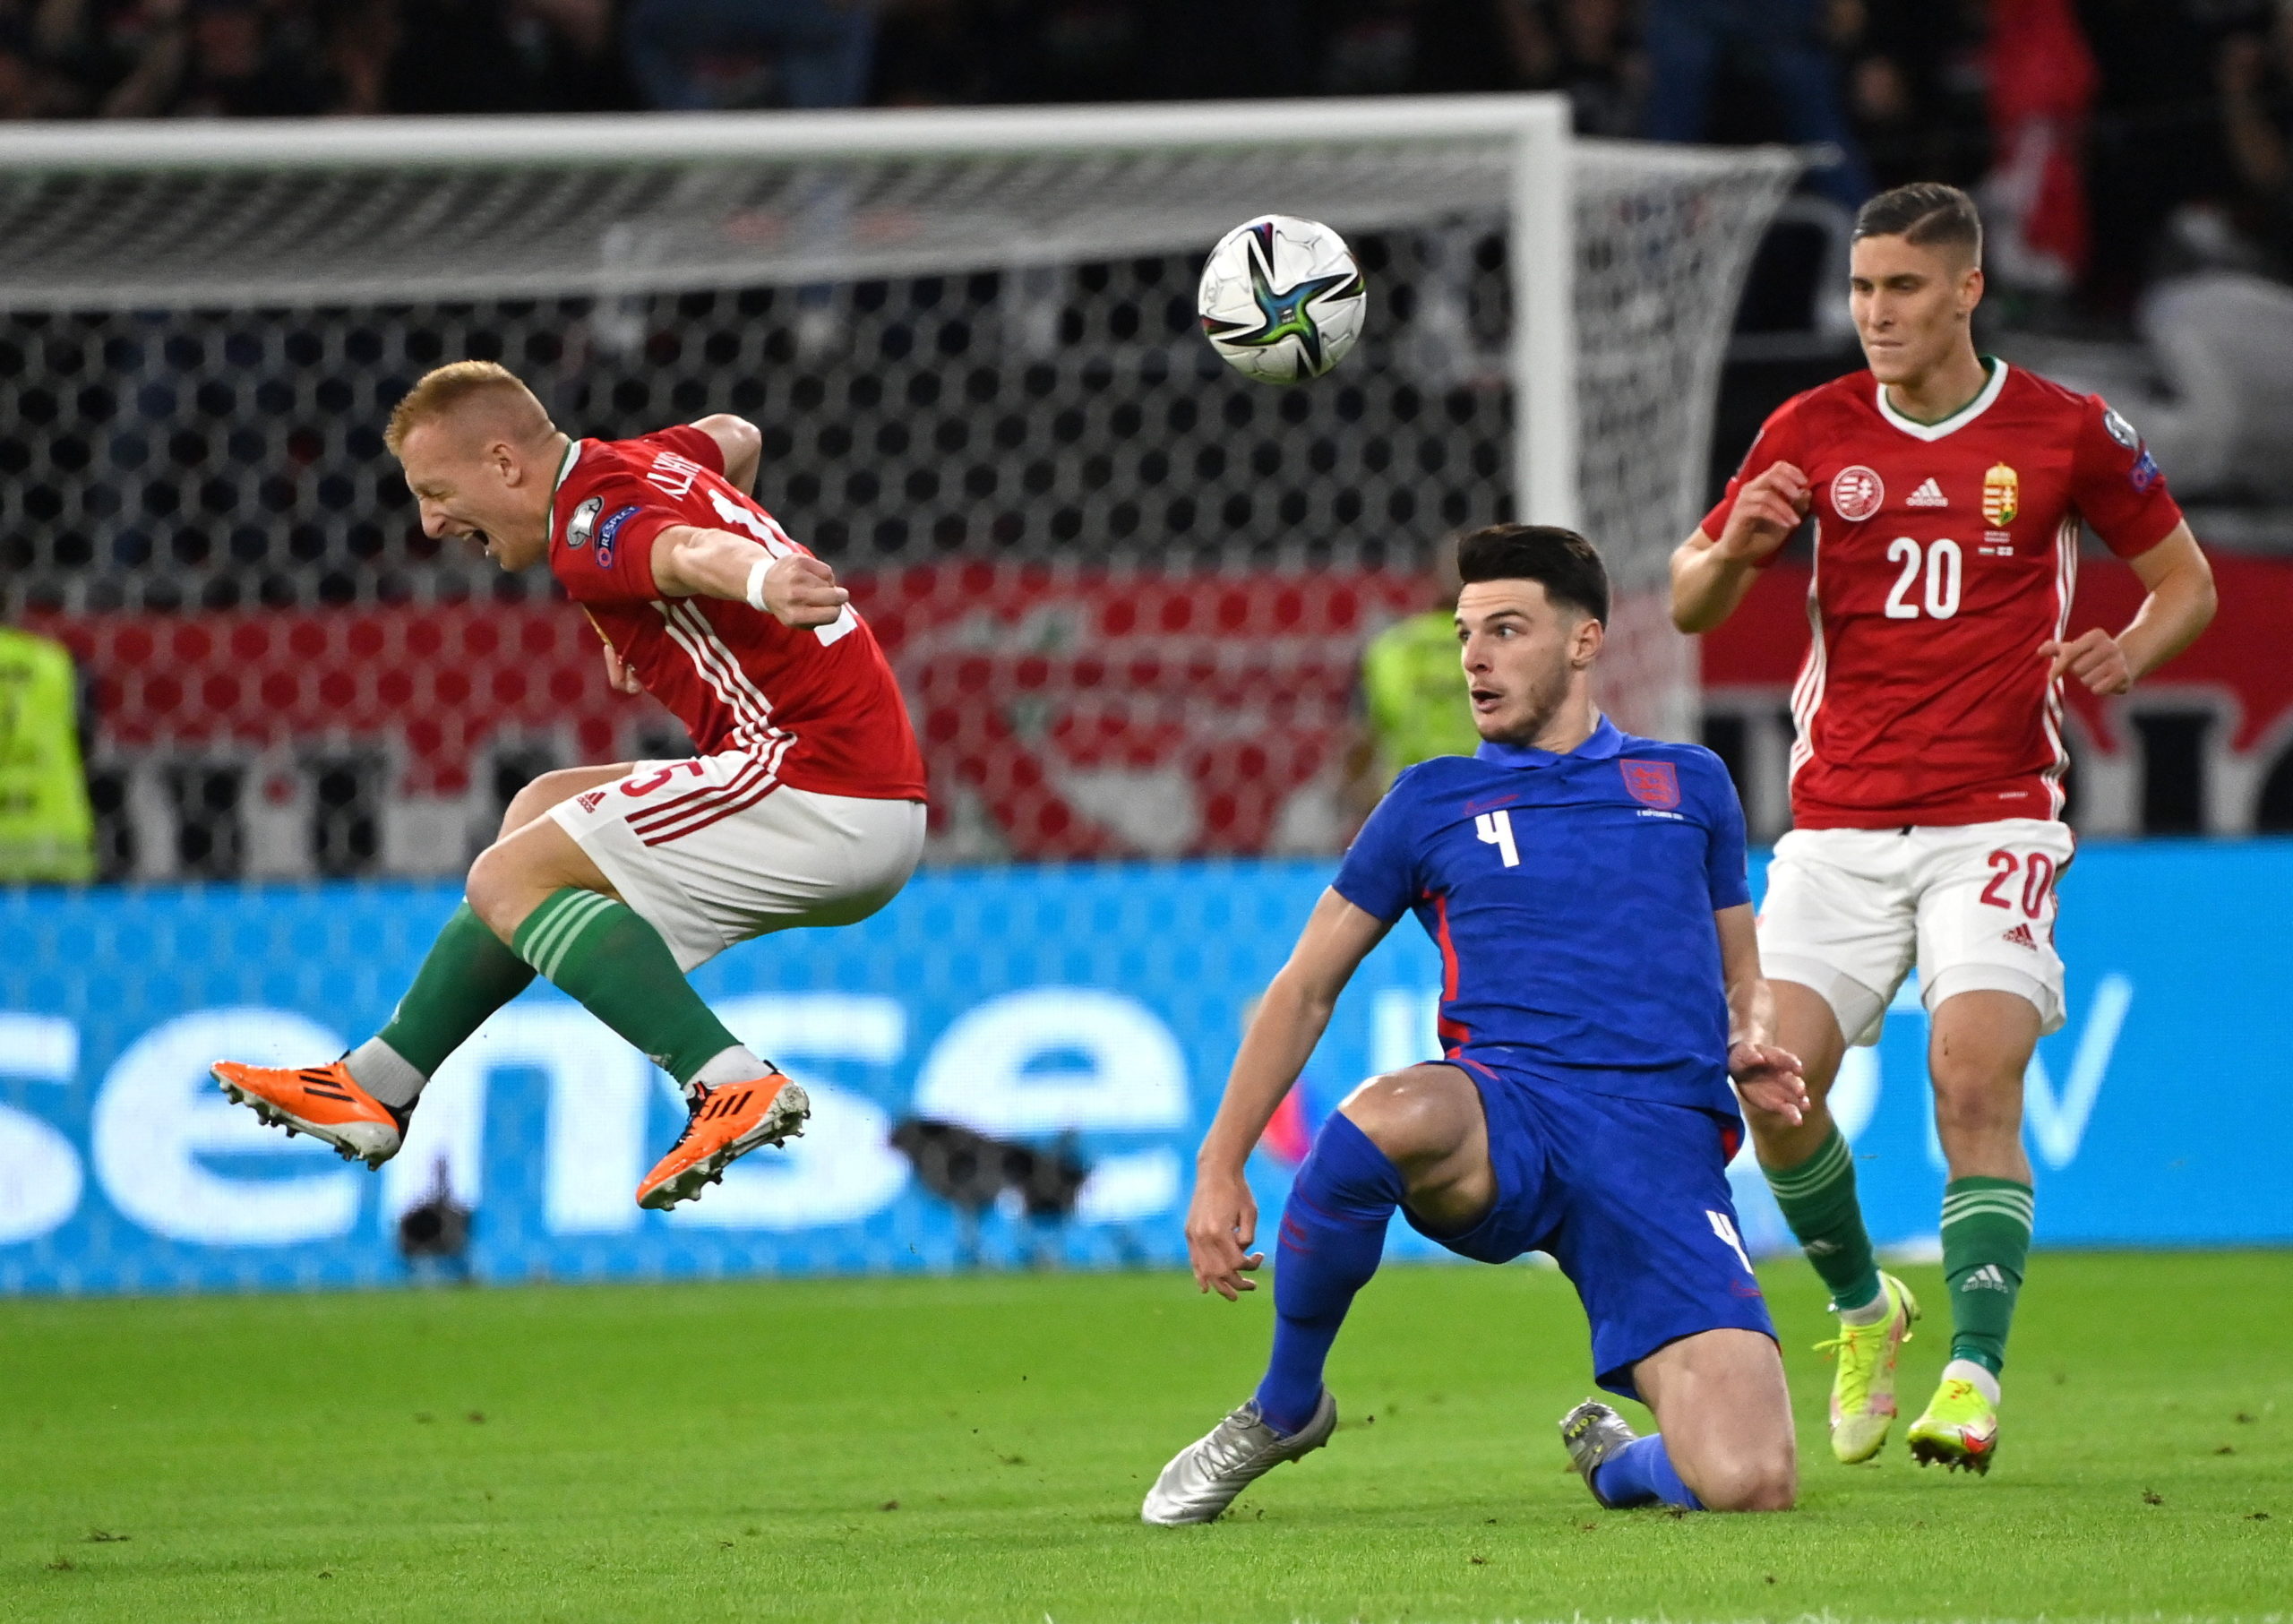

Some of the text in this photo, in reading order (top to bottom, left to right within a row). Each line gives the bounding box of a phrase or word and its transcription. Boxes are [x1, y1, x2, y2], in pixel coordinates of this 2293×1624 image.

[1885, 537, 1962, 620] 20
[1474, 809, 1520, 868] 4
[1980, 848, 2053, 919] 20
[1705, 1209, 1755, 1276] 4
